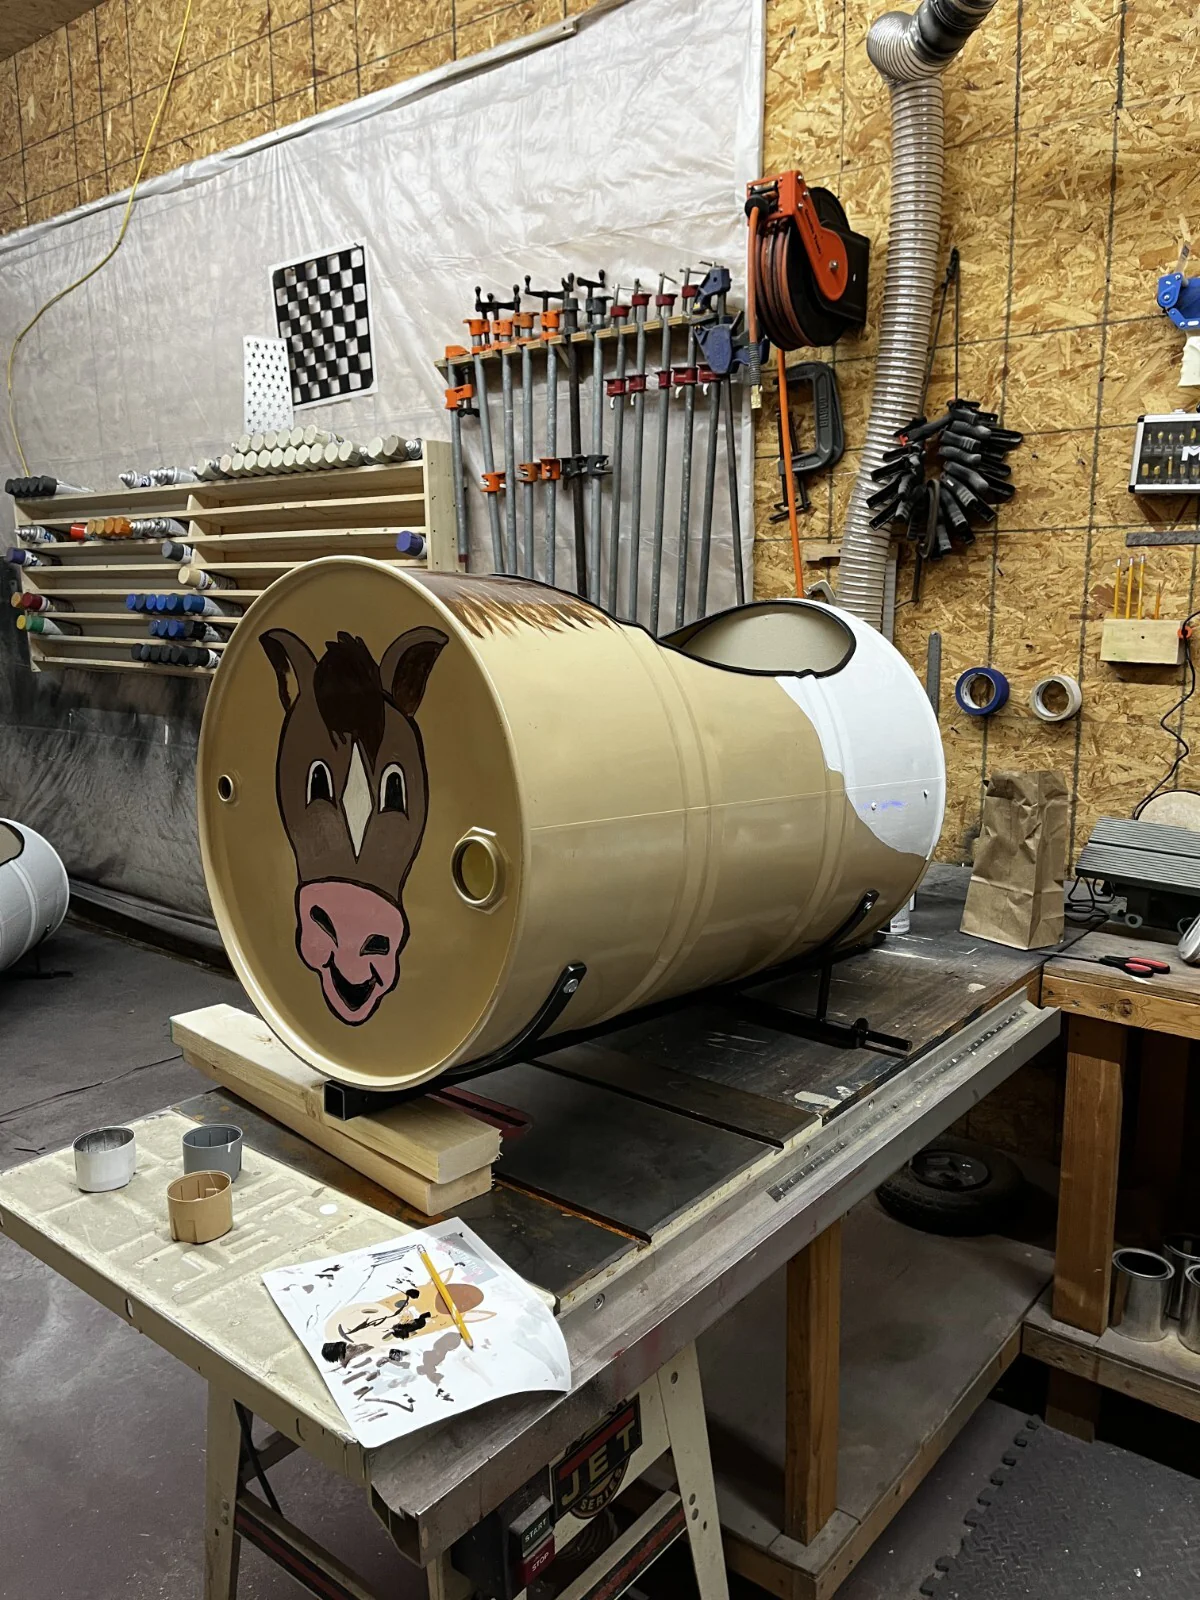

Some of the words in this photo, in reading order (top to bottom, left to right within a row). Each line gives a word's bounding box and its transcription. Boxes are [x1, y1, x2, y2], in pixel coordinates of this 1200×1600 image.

[562, 1419, 636, 1507] JET
[525, 1518, 547, 1542] START
[532, 1551, 550, 1572] STOP
